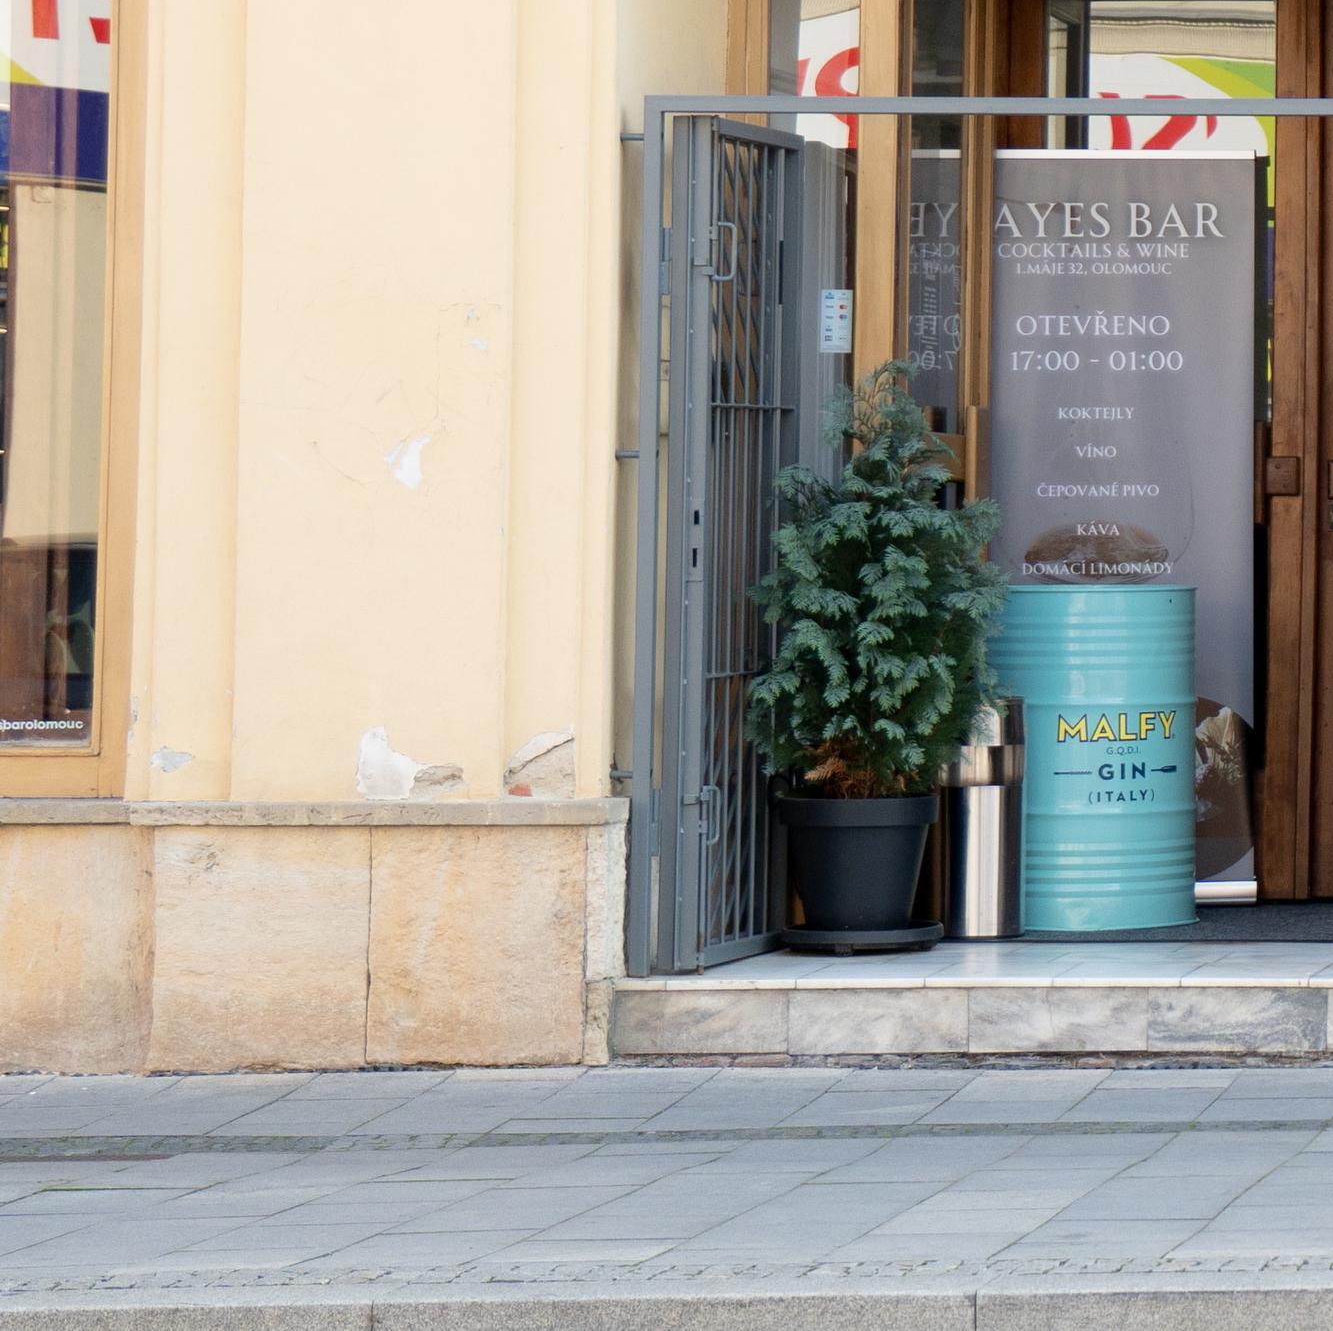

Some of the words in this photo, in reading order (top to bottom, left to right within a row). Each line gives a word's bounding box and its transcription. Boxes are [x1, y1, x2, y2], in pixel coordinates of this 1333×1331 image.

[994, 201, 1111, 239] AYES
[1127, 201, 1226, 239] BAR
[998, 243, 1112, 259] COCKTAILS
[1118, 244, 1130, 259] &
[1136, 243, 1190, 259] WINE
[1092, 262, 1173, 276] OLOMOUC
[1016, 310, 1170, 337] OTEVŘENO
[1010, 350, 1080, 371] 17:00
[1108, 350, 1184, 371] 01:00
[1058, 406, 1135, 420] KOKTEJLY
[1075, 443, 1118, 459] VÍNO
[1037, 481, 1119, 498] ČEPOVANÉ
[1123, 484, 1160, 498] PIVO
[1077, 521, 1120, 536] KÁVA
[1022, 560, 1086, 576] DOMÁCÍ
[1090, 560, 1174, 576] LIMONÁDY
[1056, 710, 1177, 743] MALFY
[1098, 762, 1147, 781] GIN
[1087, 788, 1156, 805] (ITALY)
